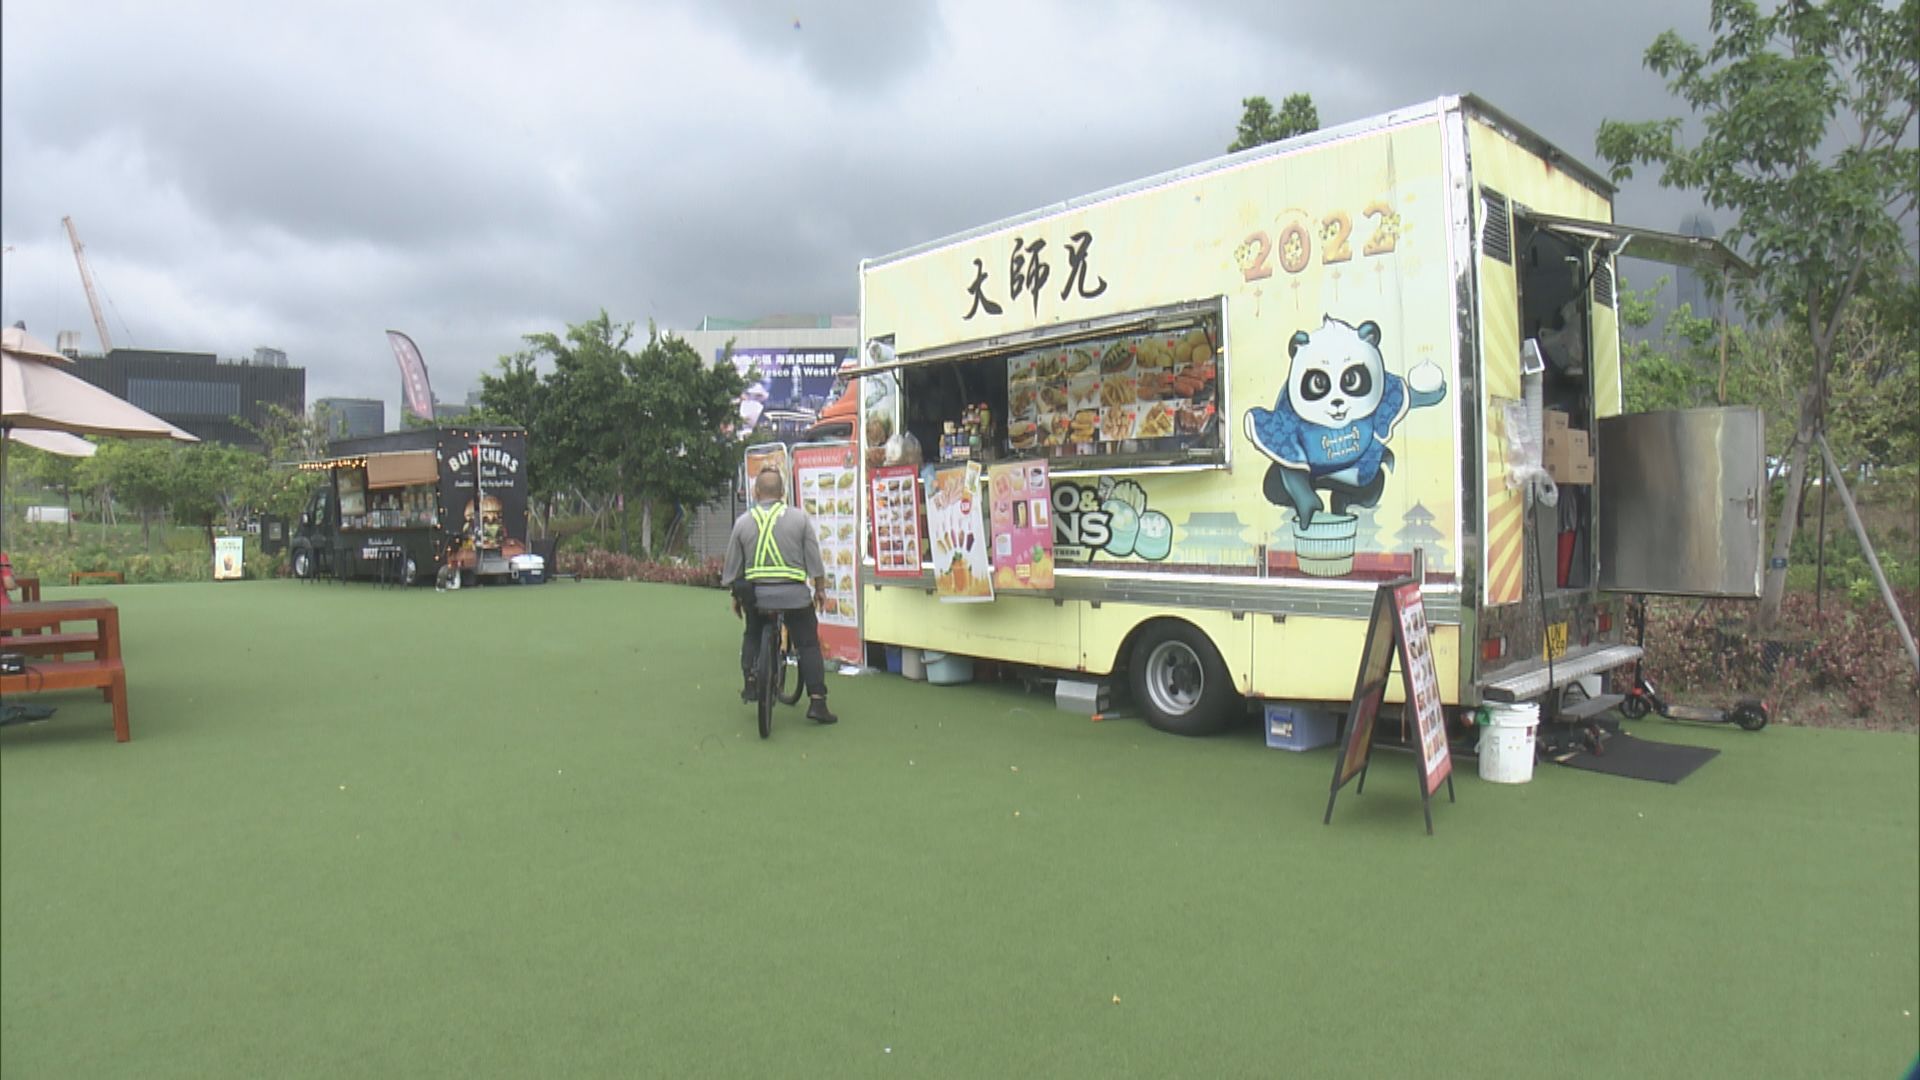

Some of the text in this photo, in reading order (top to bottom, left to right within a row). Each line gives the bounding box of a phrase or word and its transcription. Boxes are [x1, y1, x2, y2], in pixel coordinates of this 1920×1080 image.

[1240, 202, 1397, 282] 2022
[963, 231, 1108, 320] 大師兄
[803, 366, 828, 377] West
[1054, 511, 1109, 545] NS
